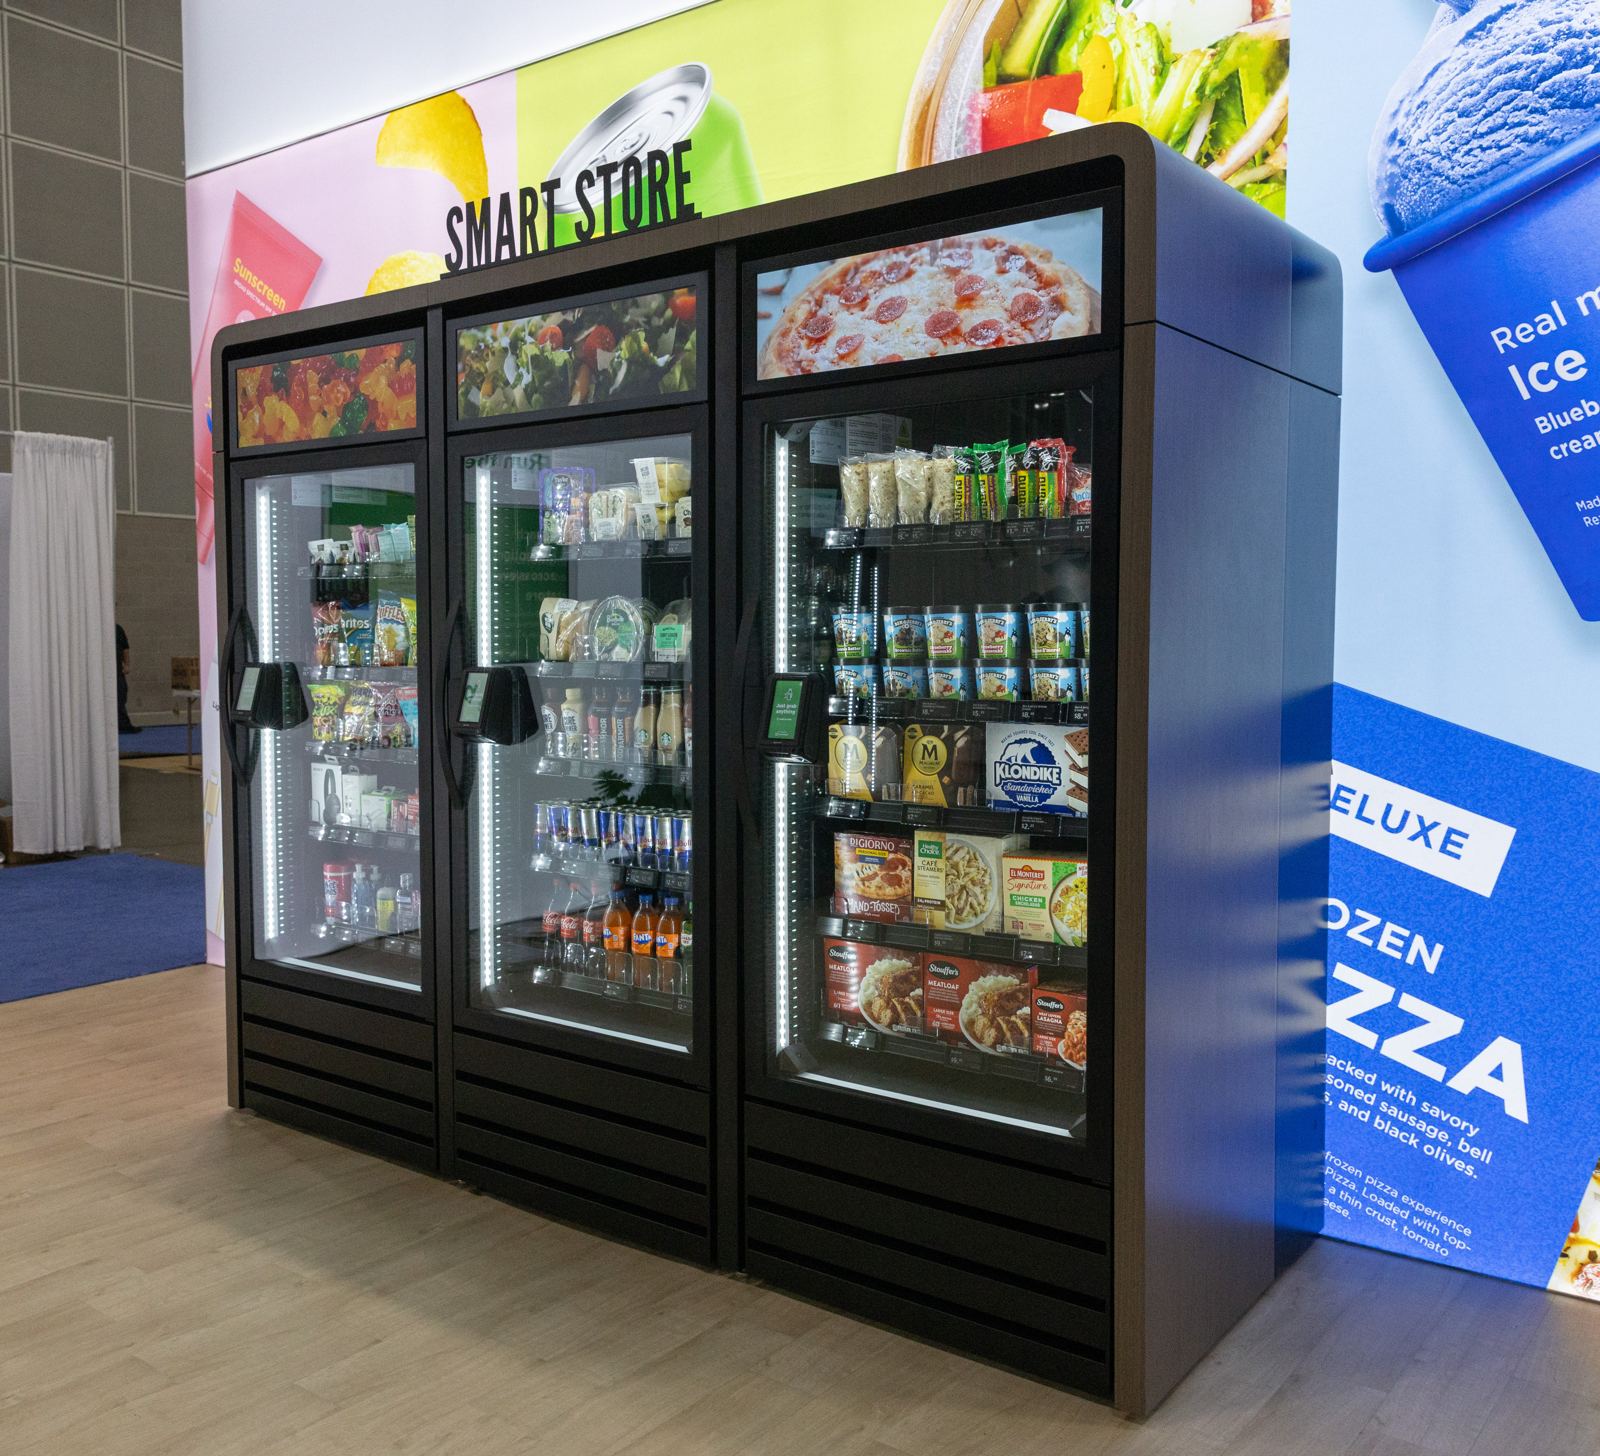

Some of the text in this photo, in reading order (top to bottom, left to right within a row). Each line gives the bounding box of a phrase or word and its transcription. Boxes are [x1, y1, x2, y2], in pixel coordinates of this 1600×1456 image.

[445, 139, 696, 271] SMART STORE
[233, 257, 287, 311] Sunscreen
[1490, 300, 1568, 354] Real
[1508, 350, 1588, 400] Ice
[1534, 399, 1600, 435] Blueb
[921, 743, 938, 761] M
[994, 761, 1062, 787] KLONDIKE
[1003, 782, 1053, 795] Sandwiches
[1016, 794, 1039, 803] VANILLA
[849, 837, 895, 851] DIGIORNO
[1330, 783, 1470, 860] ELUXE
[1007, 877, 1048, 891] Signature
[1327, 898, 1444, 975] OZEN
[928, 963, 960, 976] Stouffer's
[928, 979, 960, 990] MEATLOAF
[1036, 998, 1064, 1009] Stouffer's
[1037, 1015, 1063, 1025] LASAGNA
[1326, 962, 1529, 1124] ZZA
[1326, 1053, 1480, 1138] acked with savory
[1326, 1073, 1493, 1165] soned sausage, bell
[1338, 1099, 1371, 1123] and
[1373, 1115, 1420, 1149] black
[1423, 1144, 1479, 1180] olives.
[1325, 1150, 1473, 1237] frozen pizza experience
[1325, 1166, 1473, 1252] Pizza. Loaded with top-
[1328, 1186, 1449, 1257] a thin crust, tomato
